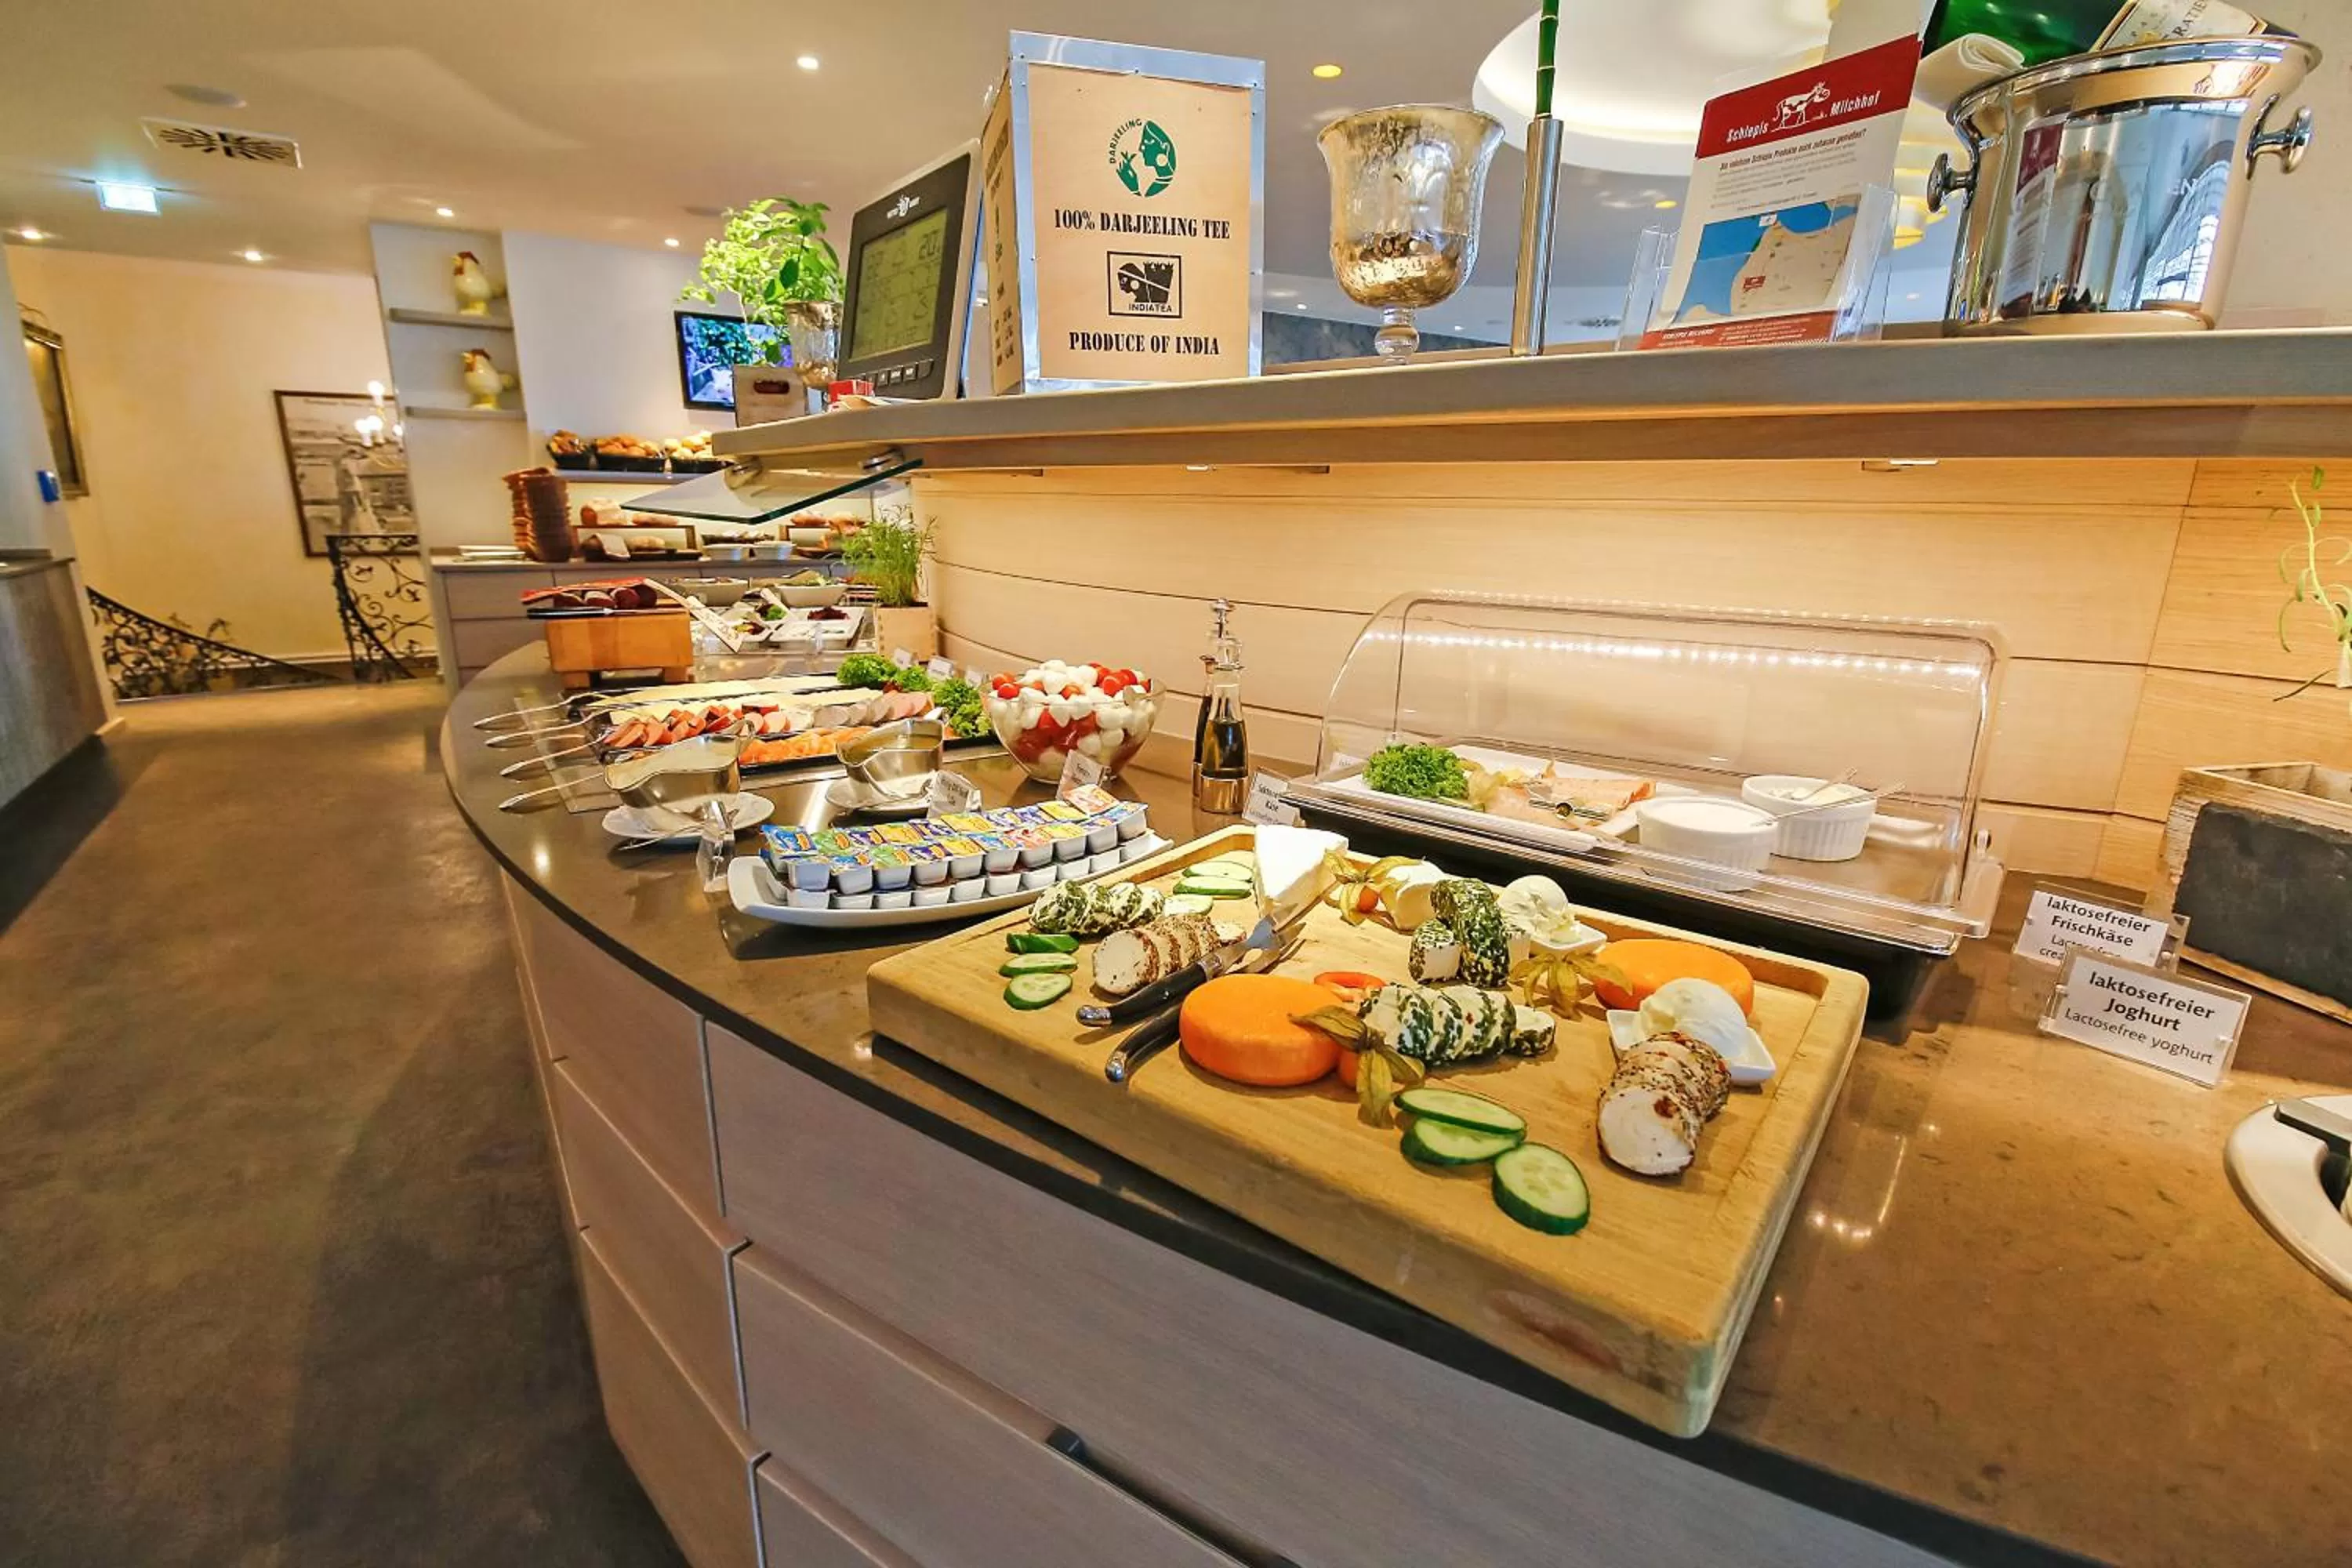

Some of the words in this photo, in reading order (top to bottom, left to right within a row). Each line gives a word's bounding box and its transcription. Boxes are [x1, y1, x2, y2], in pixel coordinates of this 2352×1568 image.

[1830, 90, 1881, 118] Milchhof
[1109, 118, 1142, 164] DARJEELING
[1054, 209, 1095, 230] 100%
[1100, 212, 1197, 238] DARJEELING
[1202, 220, 1230, 240] TEE
[1069, 332, 1145, 353] PRODUCE
[1150, 336, 1171, 354] OF
[1176, 336, 1220, 355] INDIA
[2047, 896, 2151, 933] laktosefreier
[2051, 916, 2133, 946] Frischkäse
[2039, 947, 2065, 961] crea
[2089, 971, 2215, 1020] laktosefreier
[2103, 997, 2182, 1032] Joghurt
[2064, 1007, 2147, 1043] Lactosefree
[2151, 1036, 2213, 1065] yoghurt
